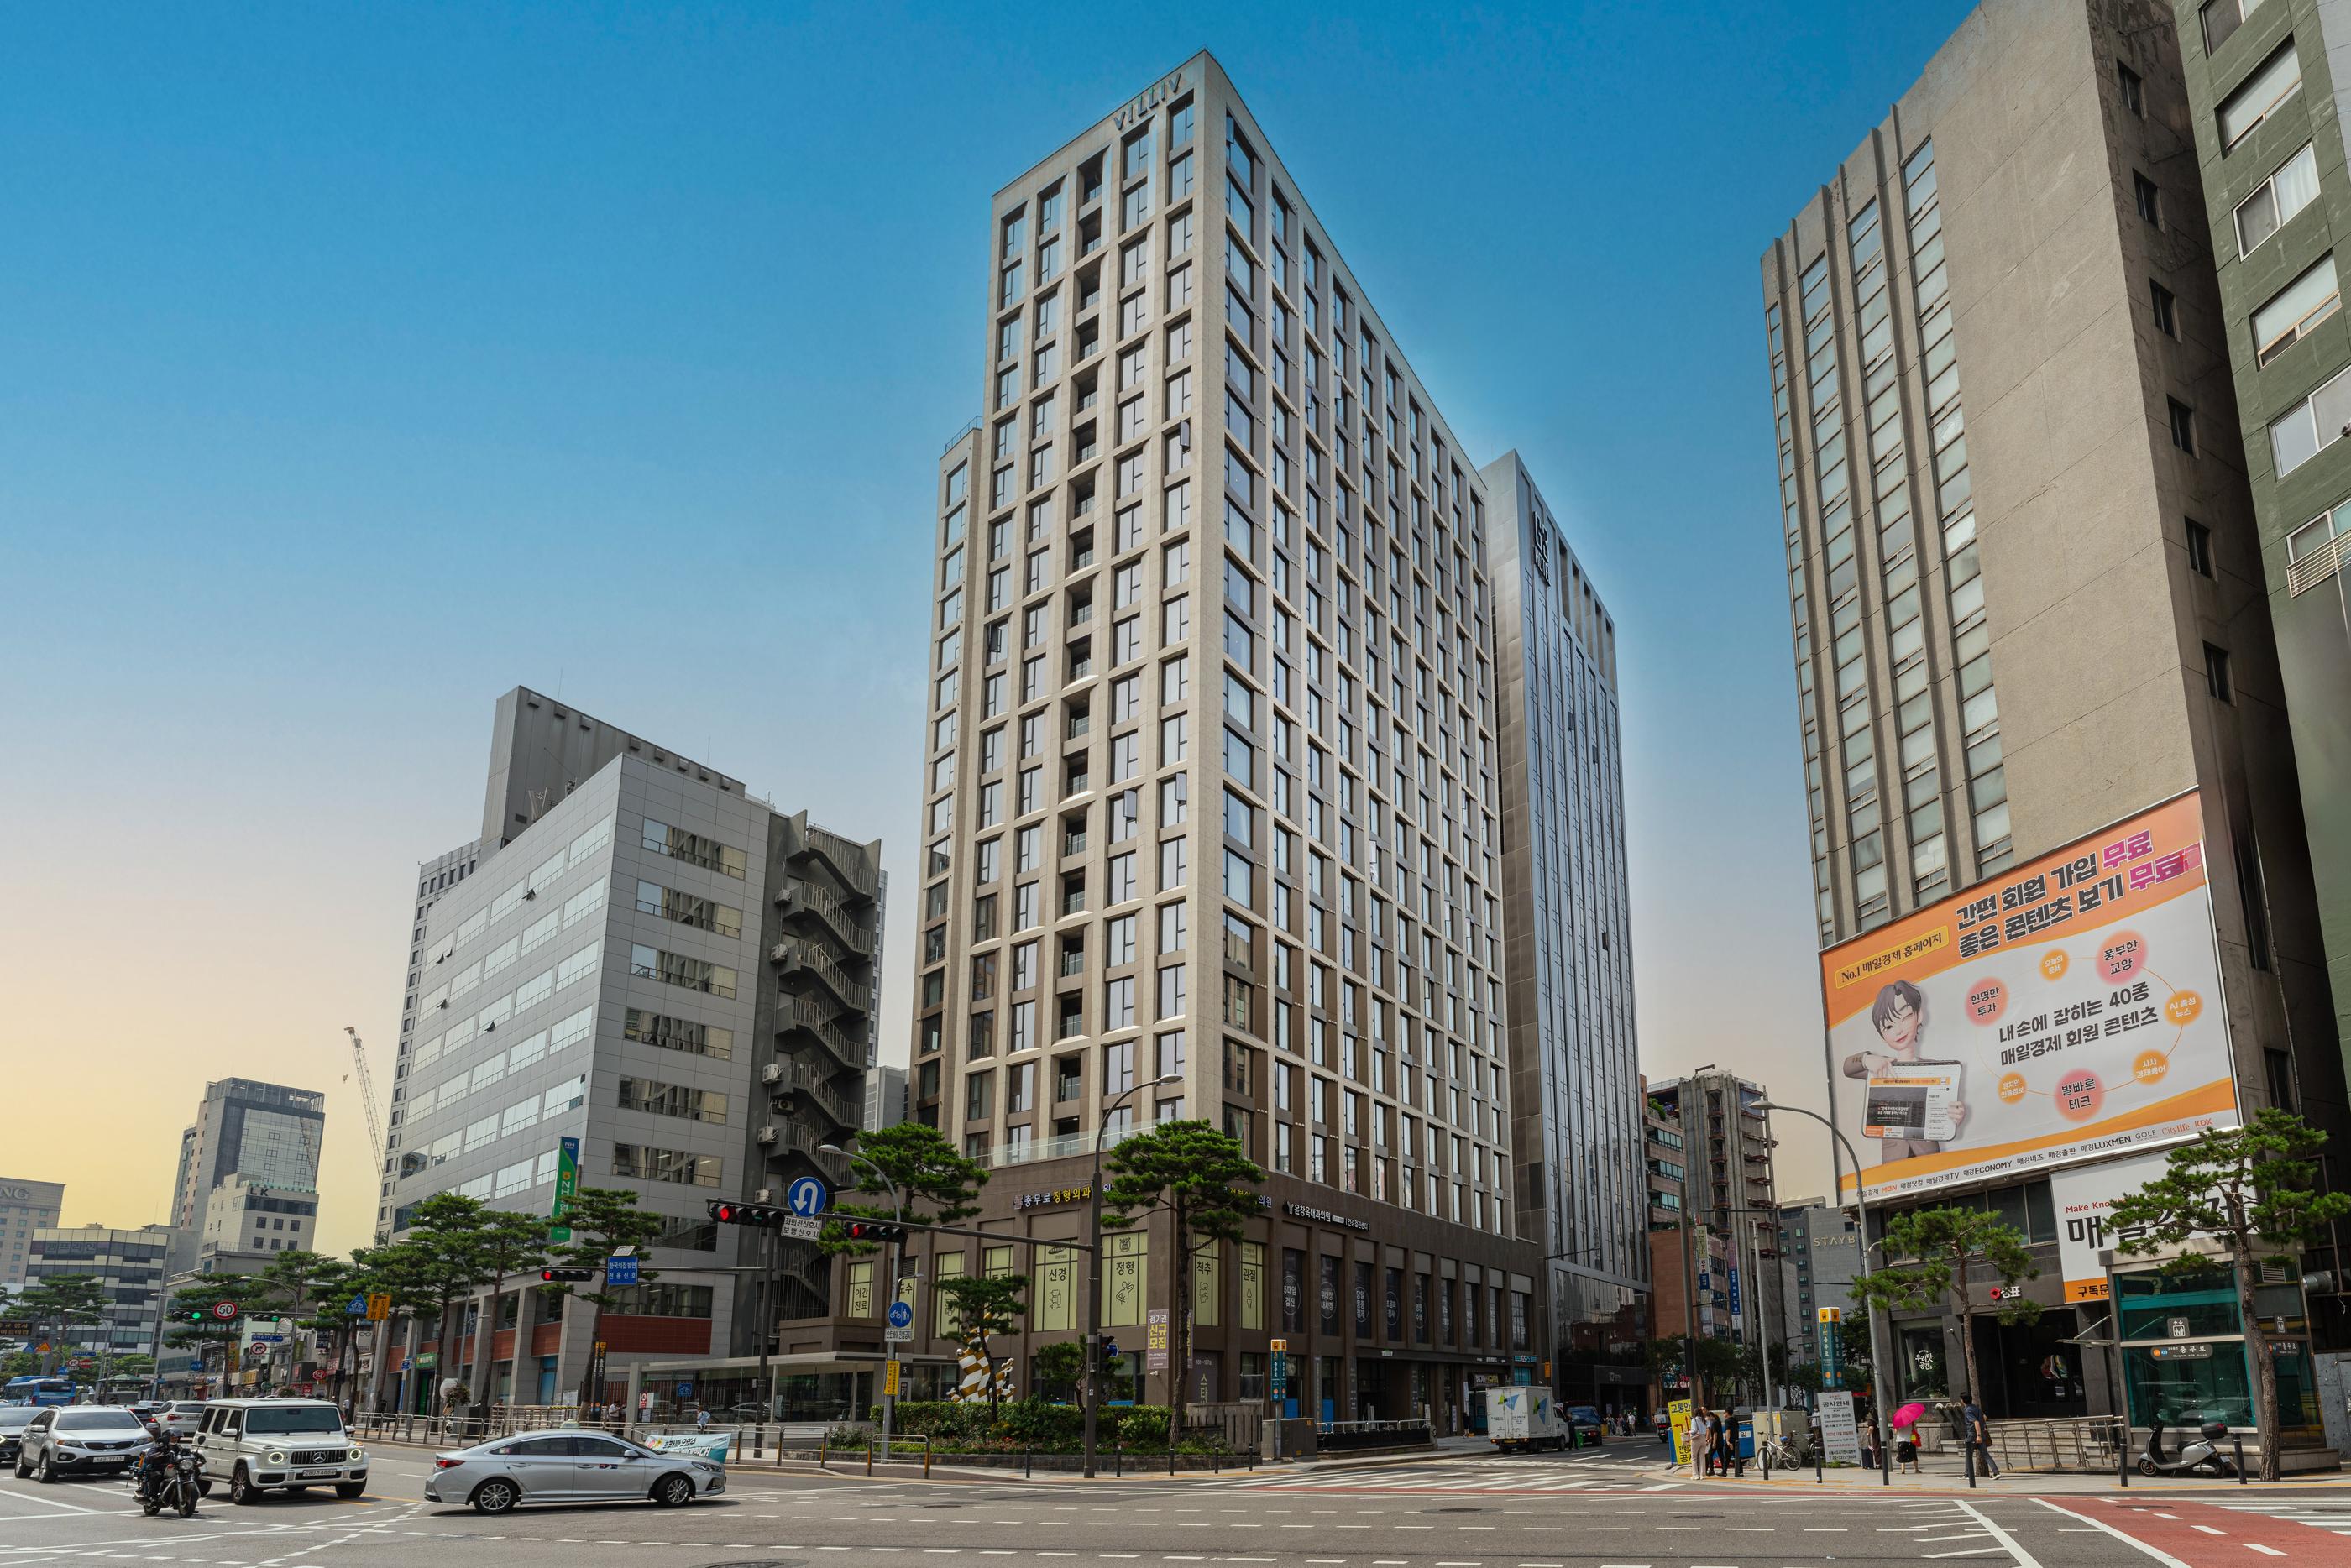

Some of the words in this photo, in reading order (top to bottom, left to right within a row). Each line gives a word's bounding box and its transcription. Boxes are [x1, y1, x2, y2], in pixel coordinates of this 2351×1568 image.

[1113, 73, 1181, 130] VILLIV
[1956, 893, 1998, 930] 간편
[2001, 873, 2046, 912] 회원
[2050, 853, 2098, 890] 가입
[2102, 828, 2153, 870] 무료
[1959, 923, 1999, 959] 좋은
[2004, 895, 2073, 943] 콘텐츠
[2077, 873, 2124, 914] 보기
[2128, 849, 2186, 891] 무료
[1840, 966, 1861, 982] No.1
[1862, 951, 1902, 973] 매일경제
[1903, 933, 1942, 958] 홈페이지
[2103, 940, 2138, 961] 풍부한
[2044, 955, 2063, 968] 오늘의
[2110, 959, 2133, 975] 교양
[1971, 987, 1999, 1005] 현명한
[1977, 1002, 1997, 1017] 투자
[2054, 1000, 2102, 1027] 잡히는
[2109, 981, 2149, 1007] 40종
[2170, 1001, 2181, 1011] AI
[2175, 1008, 2191, 1018] 뉴스
[2001, 1034, 2062, 1065] 매일경제
[2066, 1023, 2099, 1048] 회원
[2103, 1006, 2159, 1037] 콘텐츠
[2142, 1058, 2156, 1069] 시사
[2061, 1078, 2095, 1096] 발빠른
[2068, 1095, 2092, 1110] 테크
[1882, 1184, 1898, 1194] MBN
[1926, 1172, 1960, 1185] 매일경제TV
[1963, 1160, 2013, 1176] 매경ECONOMY
[2017, 1154, 2043, 1165] 매경비즈
[2048, 1147, 2076, 1159] 매경출판
[2081, 1135, 2131, 1152] 매경LUXMEN
[2135, 1129, 2156, 1139] GOLF
[2161, 1122, 2191, 1136] Citylife
[2194, 1118, 2213, 1128] KDX
[1024, 1192, 1051, 1207] 충무로
[1053, 1185, 1091, 1203] 정형외과
[2066, 1204, 2089, 1214] Make
[1049, 1267, 1066, 1282] 신경
[1116, 1261, 1134, 1275] 정형
[1196, 1261, 1212, 1276] 척추
[1243, 1268, 1256, 1283] 관절
[855, 1288, 868, 1298] 야간
[218, 1305, 233, 1315] 50
[855, 1300, 867, 1311] 진료
[1149, 1314, 1167, 1324] 정기권
[1149, 1324, 1167, 1337] 신규
[1149, 1336, 1166, 1350] 모집
[2180, 1345, 2207, 1354] 충무로
[1915, 1353, 1934, 1363] 우리맛
[1670, 1403, 1691, 1414] 교통안
